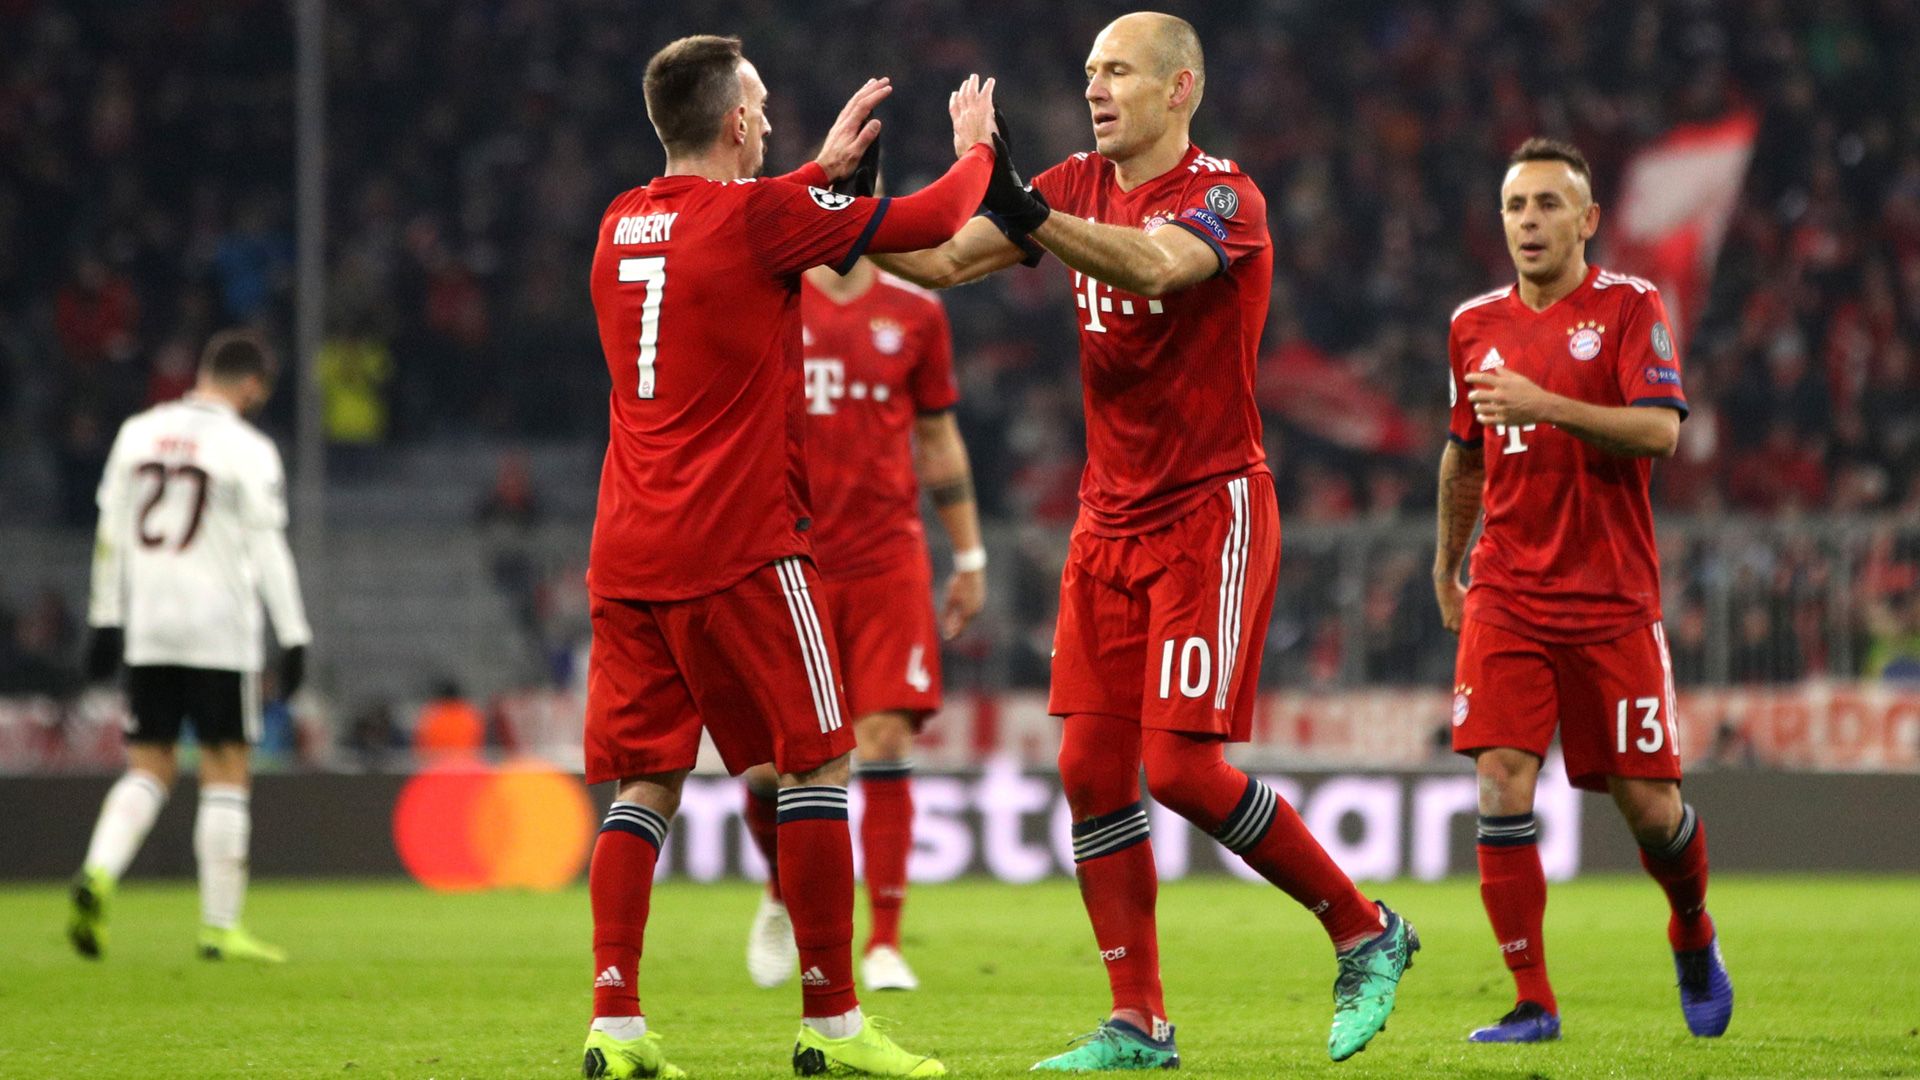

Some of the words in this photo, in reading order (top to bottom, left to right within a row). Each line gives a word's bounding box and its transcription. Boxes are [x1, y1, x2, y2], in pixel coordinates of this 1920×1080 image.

[1194, 211, 1227, 241] RESPECT
[618, 256, 666, 399] 7
[134, 462, 209, 553] 27
[905, 645, 932, 693] 4
[1159, 636, 1211, 699] 10
[1617, 697, 1664, 753] 13
[654, 748, 1584, 882] mstrard
